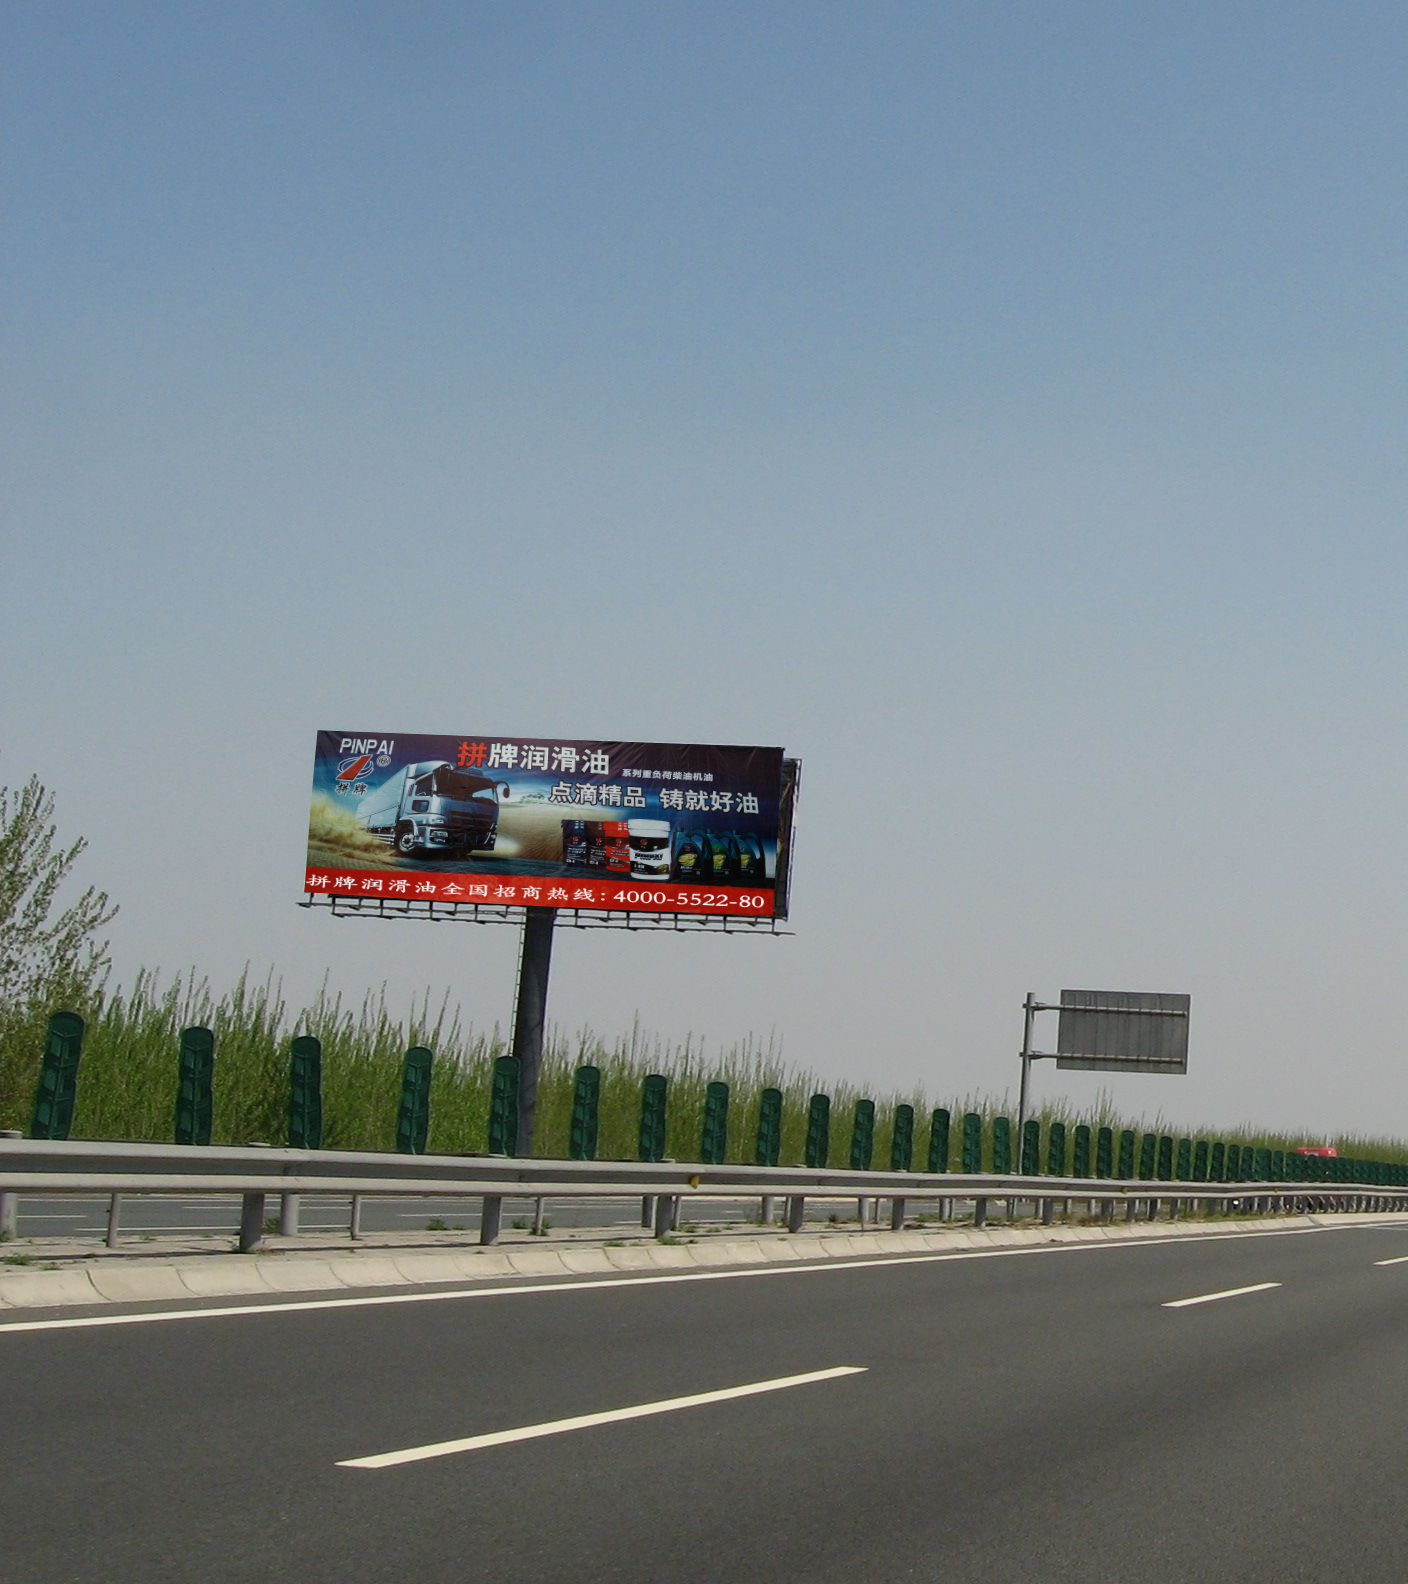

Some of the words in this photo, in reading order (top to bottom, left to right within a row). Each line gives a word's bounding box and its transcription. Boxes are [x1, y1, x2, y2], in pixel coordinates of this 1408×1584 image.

[339, 737, 395, 755] PINPAI
[457, 741, 610, 775] 拼牌润滑油
[622, 768, 714, 782] 系列重负荷柴油机油
[335, 782, 369, 797] 拼牌
[549, 781, 647, 809] 点滴精品
[658, 787, 760, 814] 铸就好油
